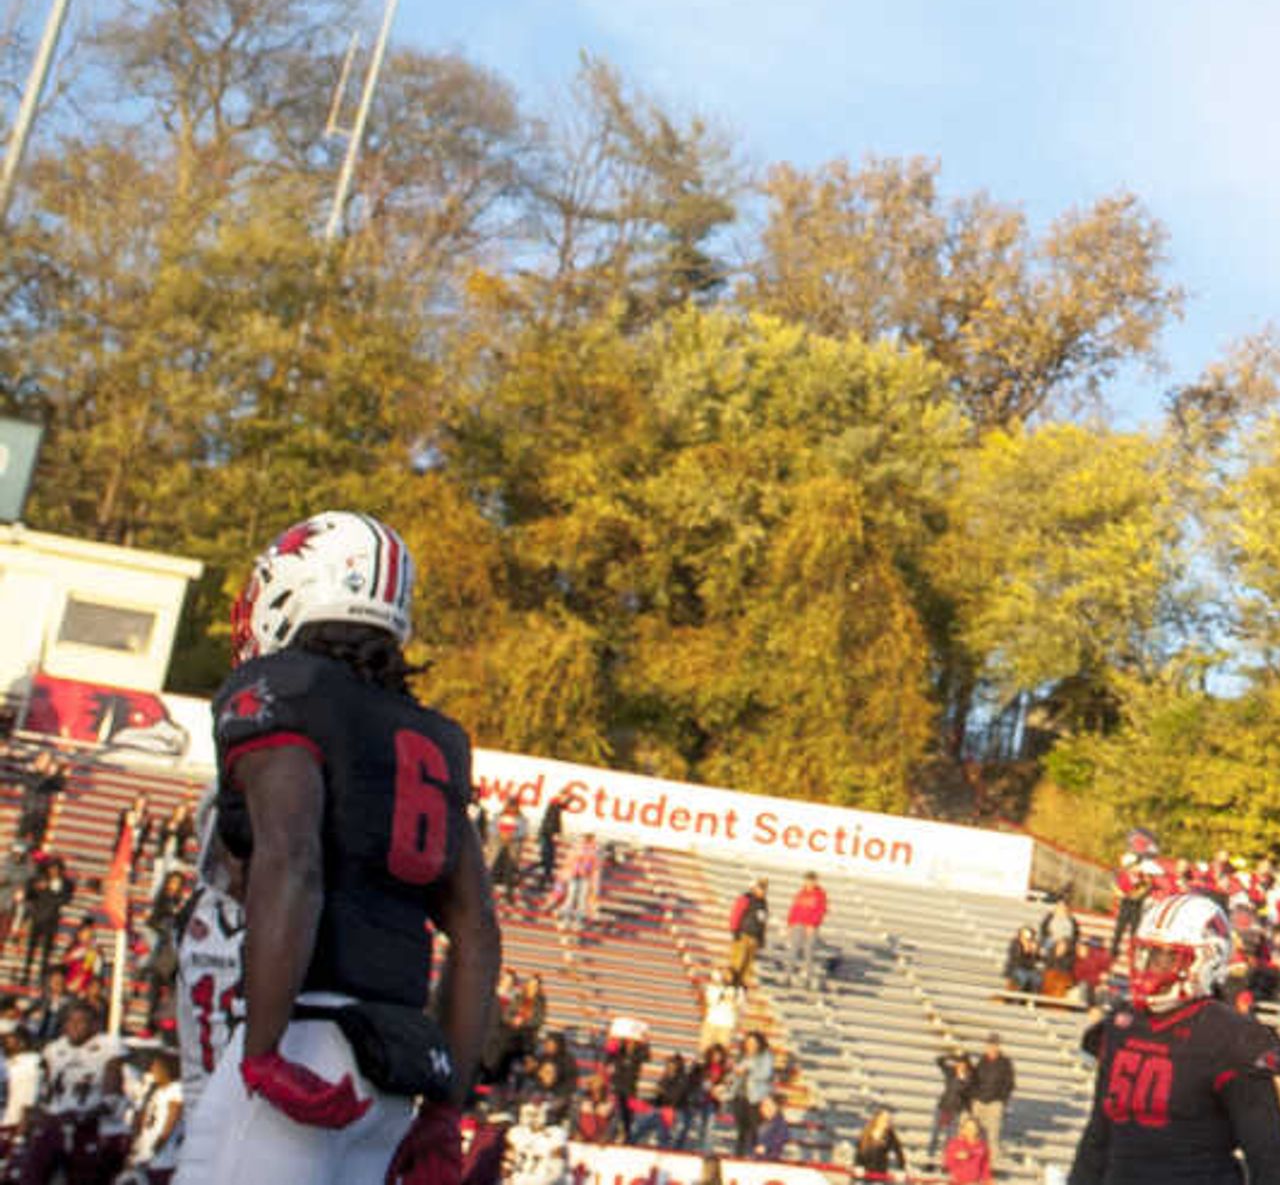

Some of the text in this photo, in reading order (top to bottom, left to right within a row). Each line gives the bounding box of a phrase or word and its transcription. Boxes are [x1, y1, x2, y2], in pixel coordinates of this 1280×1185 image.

[387, 728, 450, 886] 6
[563, 779, 738, 840] Student
[752, 811, 914, 866] Section
[1103, 1049, 1174, 1129] 50
